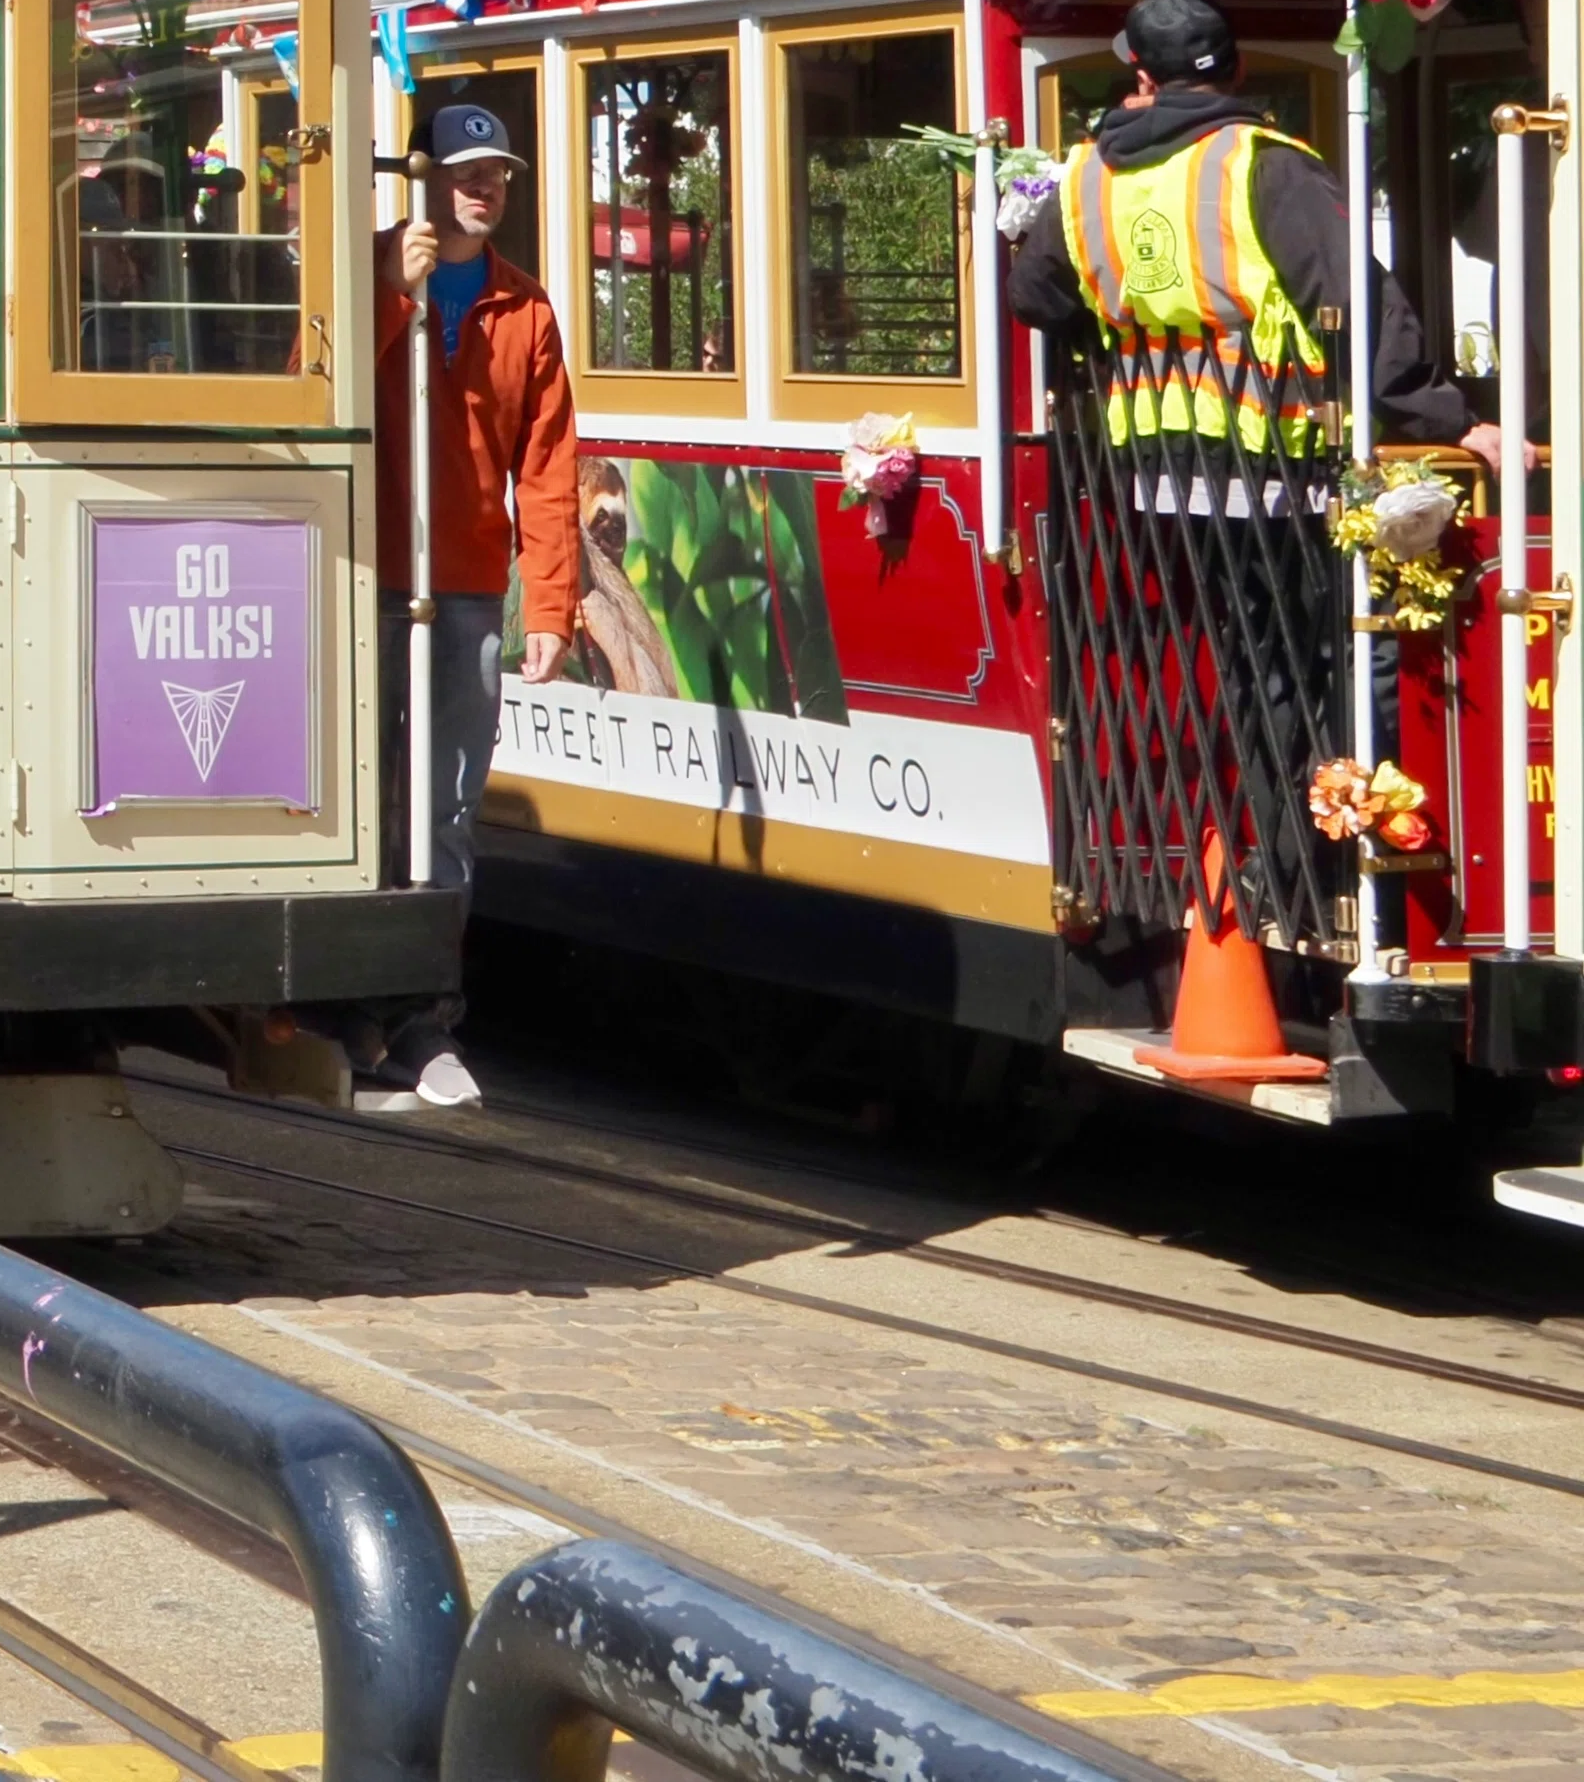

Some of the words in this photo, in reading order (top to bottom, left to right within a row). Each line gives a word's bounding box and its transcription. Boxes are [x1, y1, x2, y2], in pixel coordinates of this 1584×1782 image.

[176, 544, 230, 598] GO
[128, 605, 273, 660] VALKS!
[651, 721, 841, 804] RAILWAY
[868, 753, 945, 821] CO.
